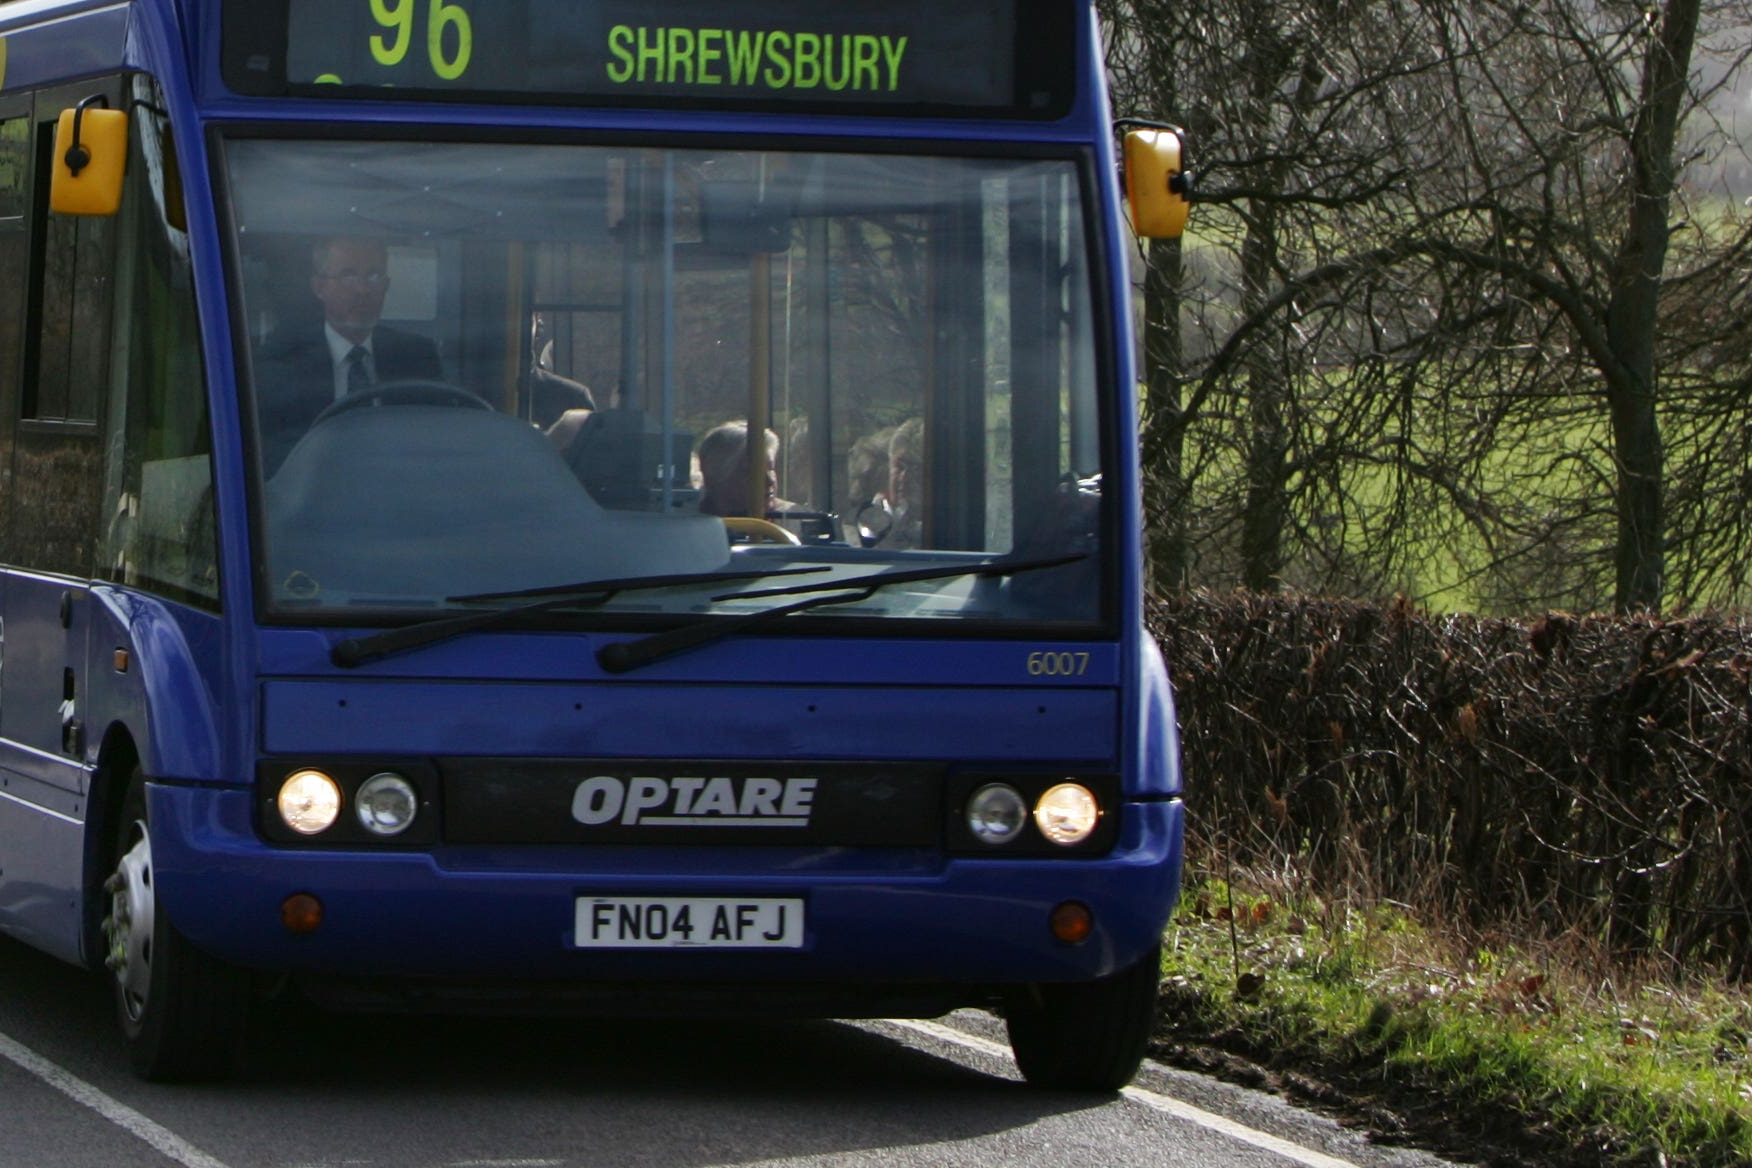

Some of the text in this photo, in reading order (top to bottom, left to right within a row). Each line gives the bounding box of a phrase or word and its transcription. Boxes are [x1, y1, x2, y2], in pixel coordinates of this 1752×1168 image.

[606, 25, 908, 92] SHREWSBURY
[1027, 651, 1091, 676] 6007
[571, 776, 819, 826] OPTARE
[591, 903, 787, 941] FN04 AFJ
